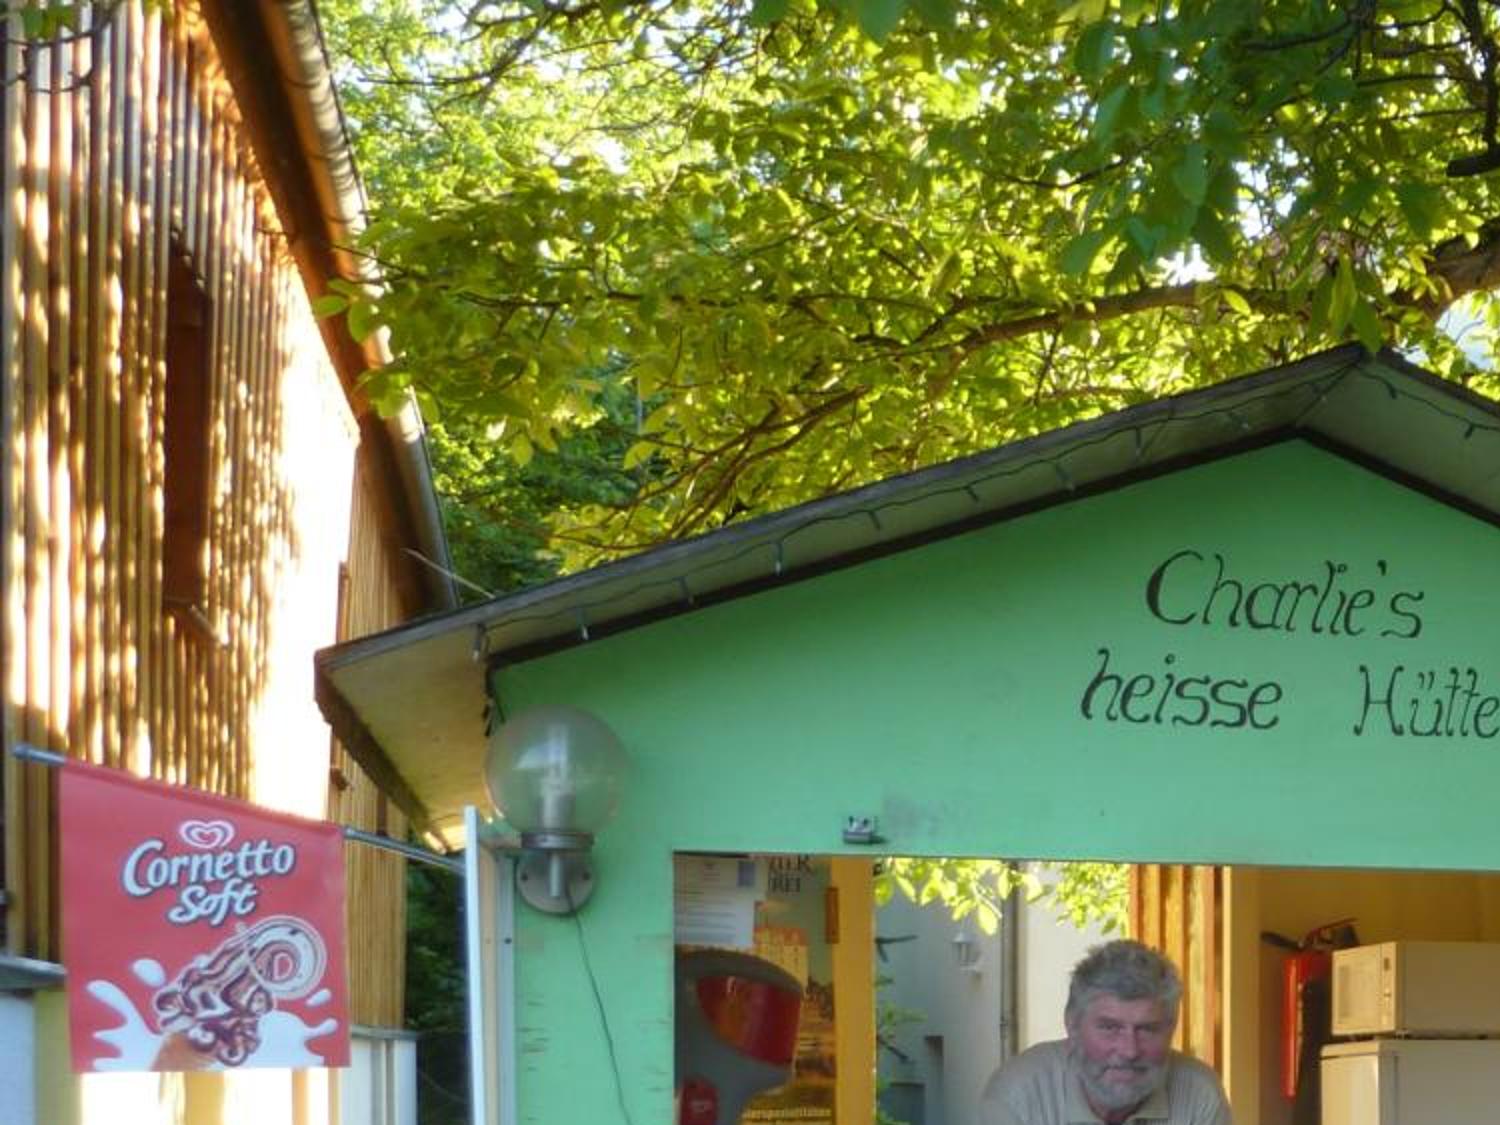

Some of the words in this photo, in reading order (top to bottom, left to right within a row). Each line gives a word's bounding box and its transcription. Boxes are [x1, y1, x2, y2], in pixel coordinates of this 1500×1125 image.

[1144, 549, 1425, 639] Charlie's
[1080, 648, 1283, 730] heisse
[1353, 664, 1500, 739] Hütte
[121, 840, 296, 897] Cornetto
[165, 877, 259, 926] Soft
